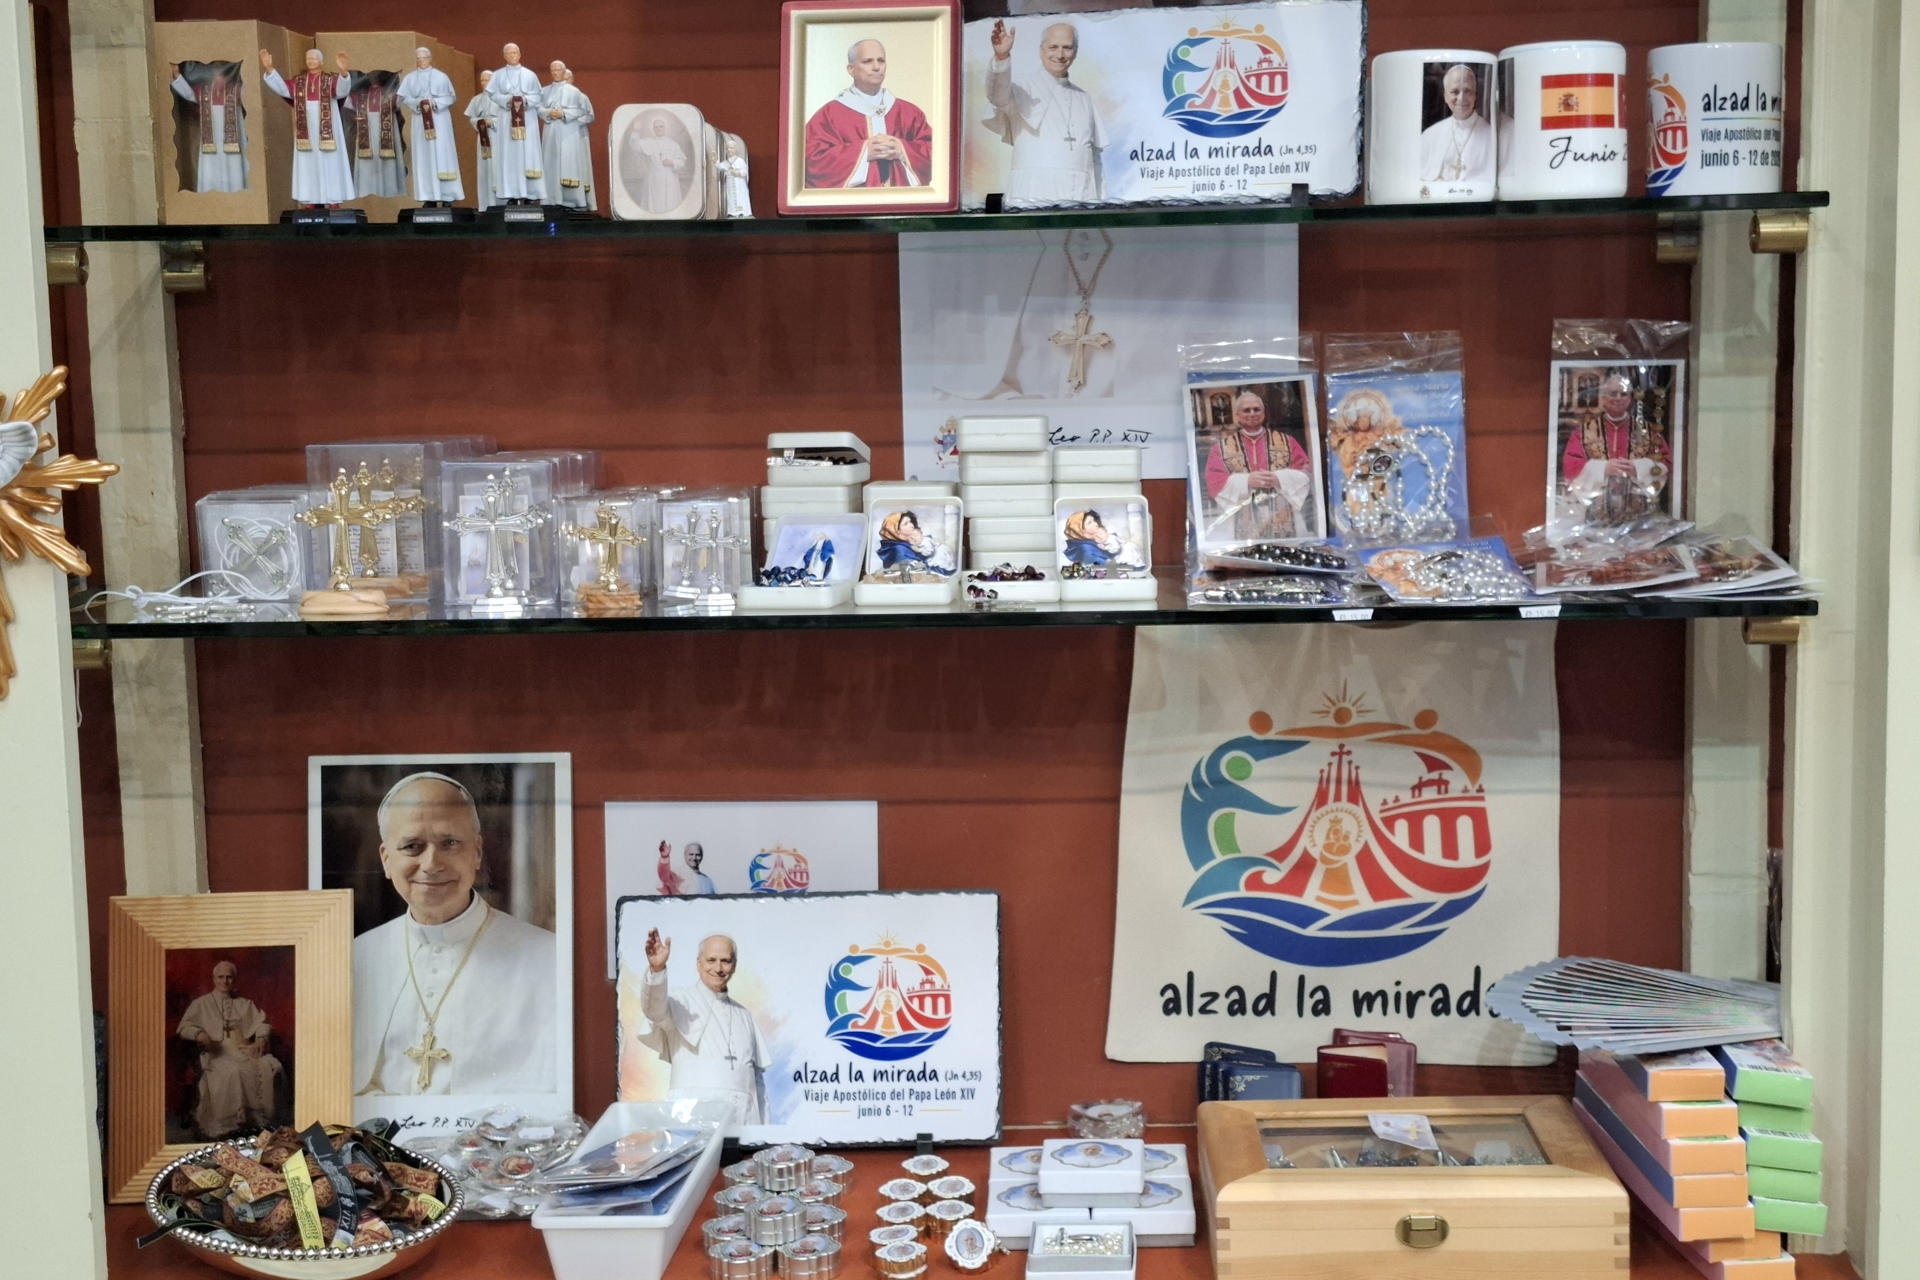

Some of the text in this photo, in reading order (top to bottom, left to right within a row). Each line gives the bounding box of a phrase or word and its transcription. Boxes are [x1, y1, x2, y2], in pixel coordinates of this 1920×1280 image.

[1702, 82, 1750, 112] alzad
[1756, 83, 1767, 112] la
[1701, 128, 1721, 143] Viaje
[1130, 141, 1176, 161] alzad
[1184, 140, 1200, 160] la
[1208, 138, 1274, 159] mirada
[1549, 136, 1618, 169] Junio
[1701, 149, 1729, 169] junio
[1732, 149, 1739, 166] 6
[1749, 149, 1758, 166] 12
[1140, 161, 1310, 181] Viaje Apostólico del Papa León XIV
[1191, 181, 1216, 194] junio
[1220, 180, 1225, 190] 6
[1237, 179, 1248, 190] 12
[1049, 427, 1081, 445] Leo
[1160, 970, 1277, 1017] alzad
[1297, 974, 1331, 1018] la
[793, 1062, 840, 1084] alzad
[849, 1061, 865, 1083] la
[873, 1061, 939, 1084] mirada
[804, 1087, 976, 1105] Viaje Apostólico del Papa León XIV
[857, 1105, 882, 1119] junio
[886, 1105, 891, 1116] 6
[903, 1105, 914, 1116] 12
[401, 1115, 426, 1130] Leo
